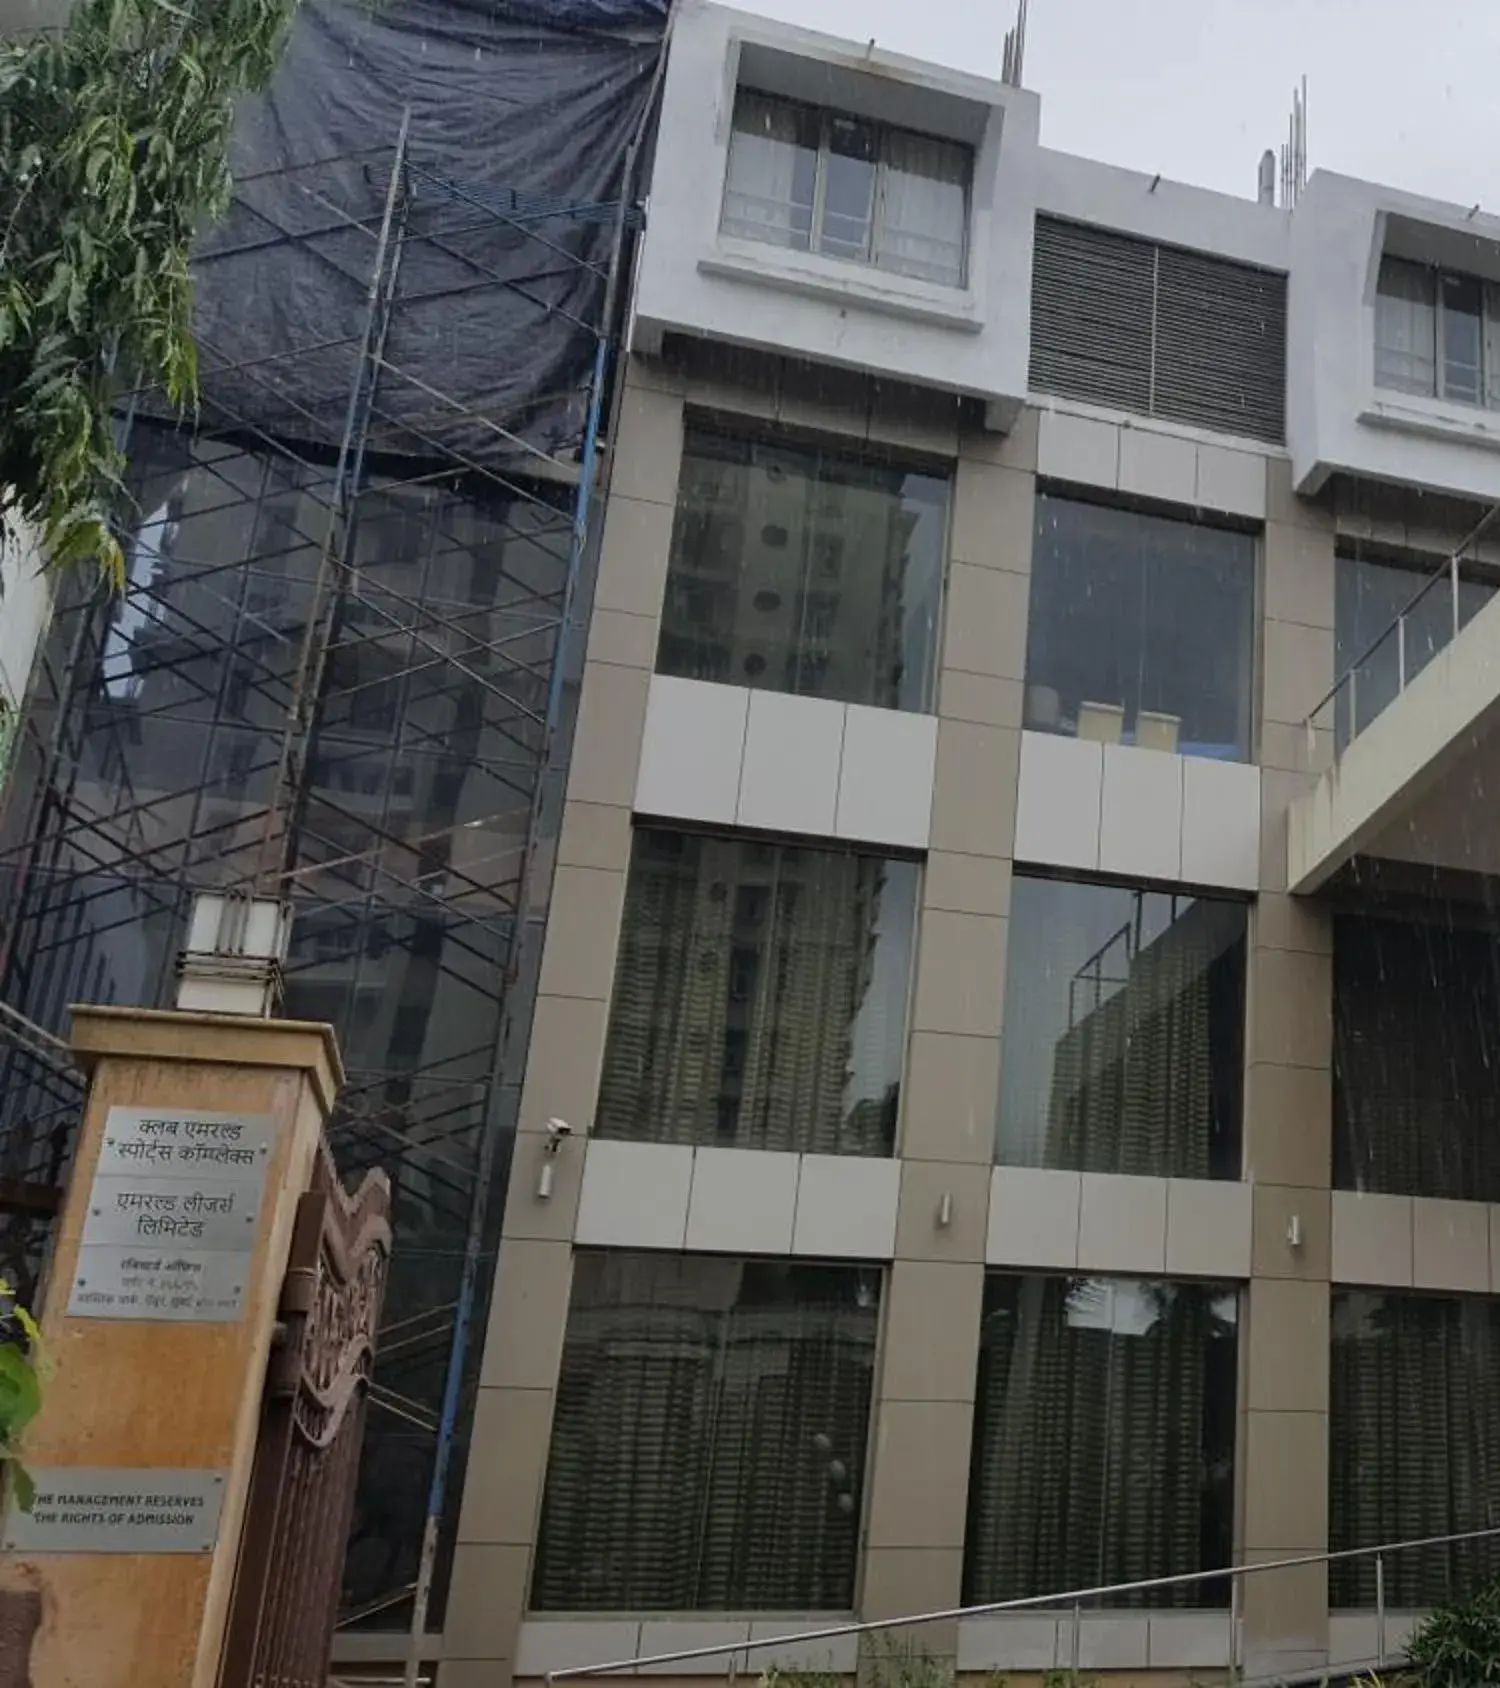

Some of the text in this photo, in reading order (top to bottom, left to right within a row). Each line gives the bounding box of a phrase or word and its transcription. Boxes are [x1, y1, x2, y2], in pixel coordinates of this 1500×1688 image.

[139, 1119, 179, 1136] क्लब
[57, 1494, 143, 1507] MANAGEMENT
[144, 1495, 204, 1508] RESERVES
[61, 1512, 105, 1526] RIGHTS
[107, 1513, 126, 1525] OF
[127, 1512, 195, 1527] ADMISSION
